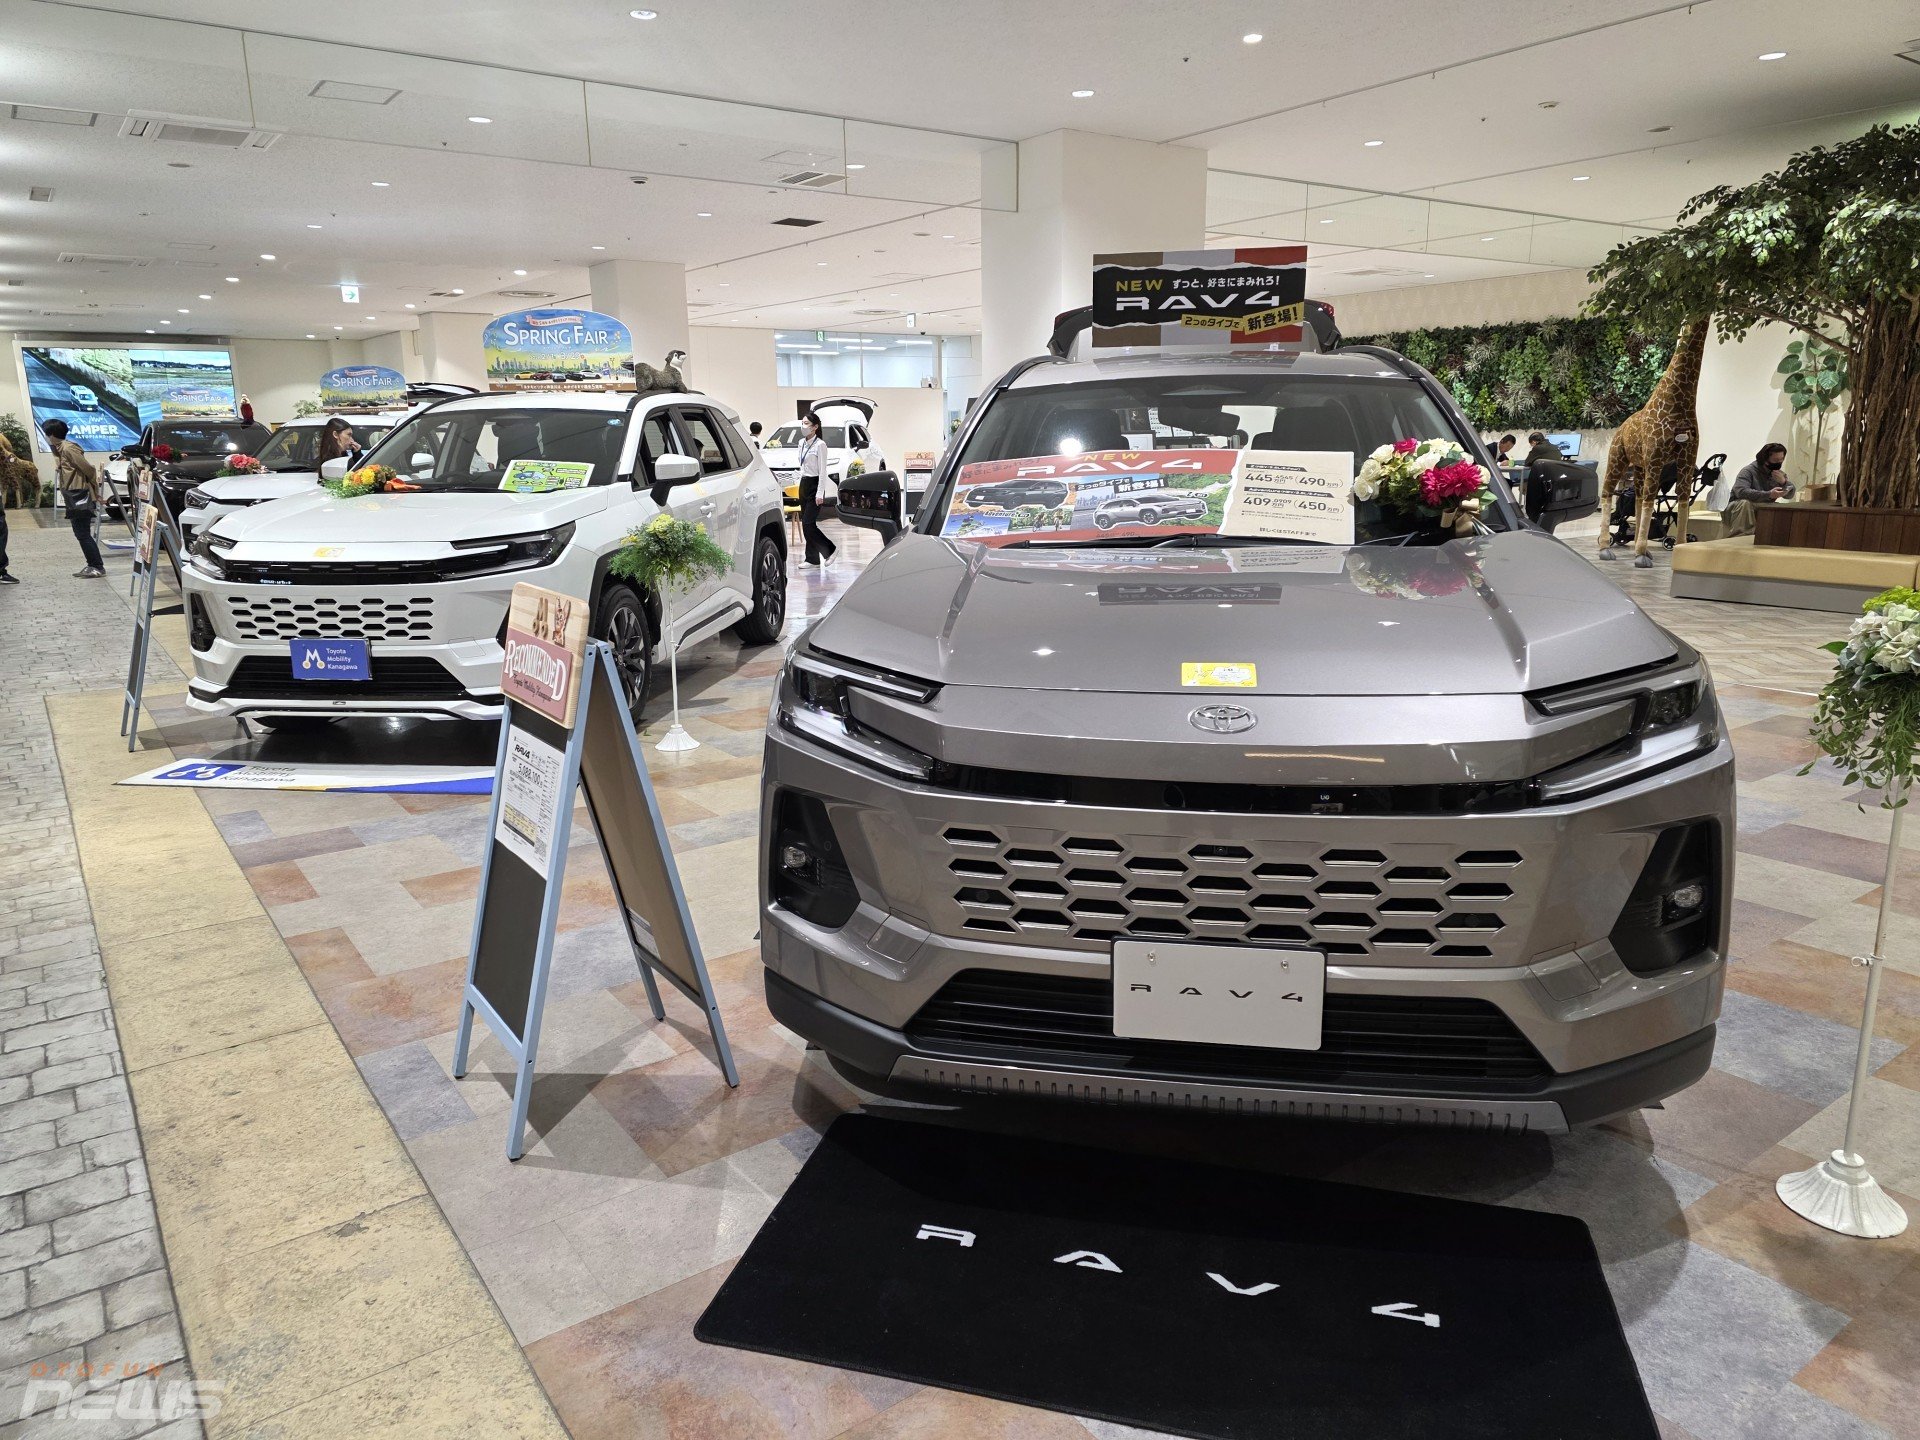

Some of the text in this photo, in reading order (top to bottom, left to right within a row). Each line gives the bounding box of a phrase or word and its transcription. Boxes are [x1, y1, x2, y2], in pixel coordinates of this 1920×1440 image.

[1115, 279, 1164, 292] NEW
[1116, 290, 1280, 311] RAV4
[1246, 305, 1299, 331] 新登場!
[503, 322, 609, 346] SPRING FAIR
[332, 373, 393, 387] SPRING FAIR
[170, 391, 204, 402] SPRING
[1084, 453, 1140, 461] NEW
[1017, 458, 1203, 477] RAV4
[1245, 473, 1273, 482] 445
[1243, 497, 1272, 506] 409
[327, 663, 358, 671] Kanagawa
